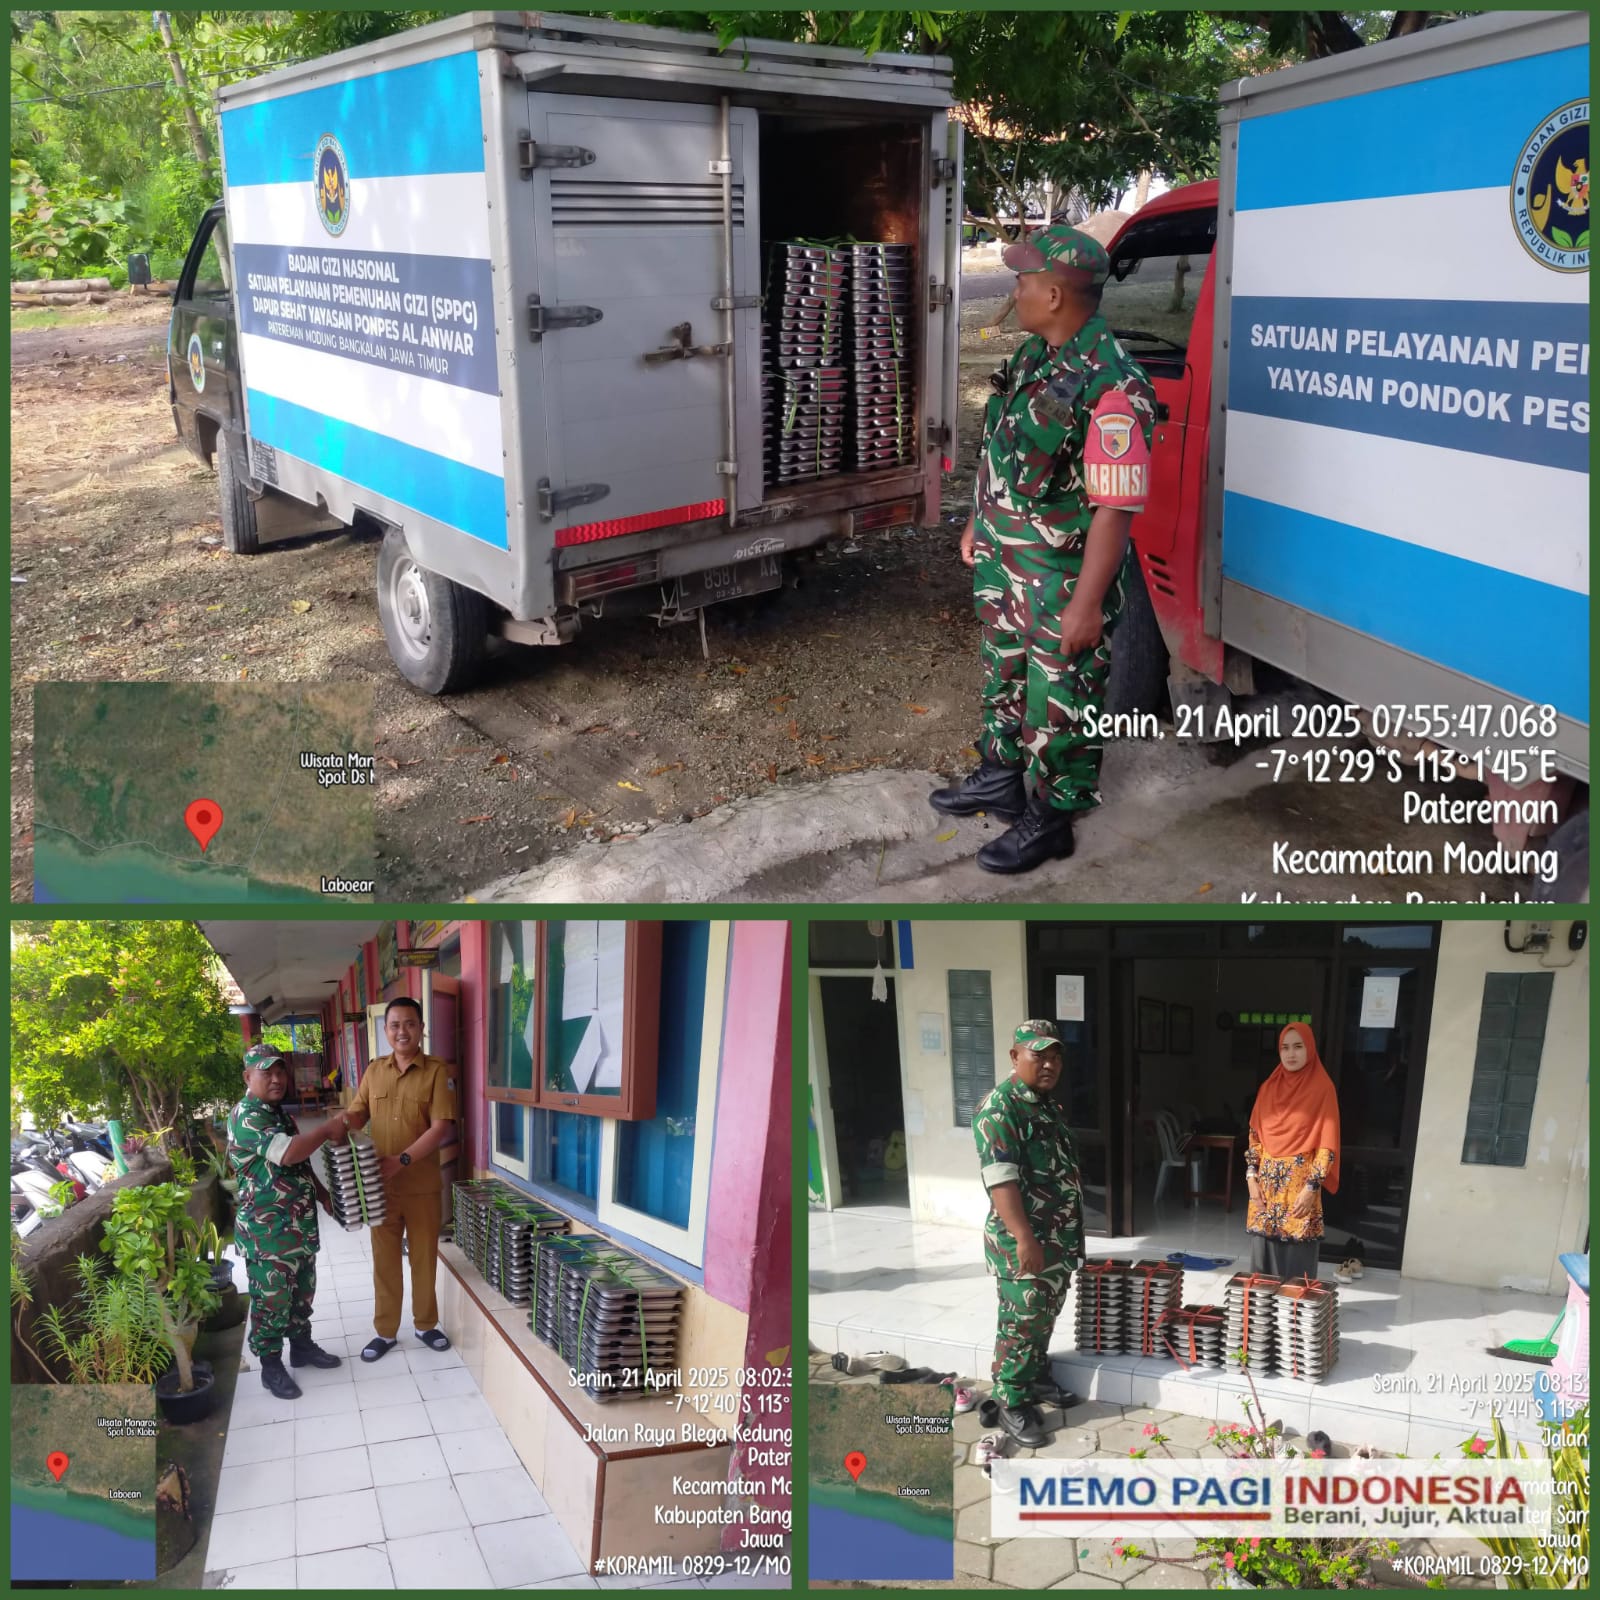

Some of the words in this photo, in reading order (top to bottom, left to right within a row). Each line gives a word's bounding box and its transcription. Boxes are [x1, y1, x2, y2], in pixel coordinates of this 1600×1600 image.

[1522, 123, 1556, 174] BADAN
[1559, 106, 1587, 126] GIZI
[1519, 209, 1566, 264] REPUBLIK
[1572, 252, 1590, 265] IN
[288, 254, 320, 275] BADAN
[322, 257, 341, 277] GIZI
[343, 259, 399, 283] NASIONAL
[248, 273, 278, 293] SATUAN
[278, 277, 331, 300] PELAYANAN
[332, 284, 401, 312] PEMENUHAN
[403, 293, 429, 317] GIZI
[431, 295, 478, 331] (SPPG)
[252, 296, 279, 317] DAPUR
[280, 301, 307, 322] SEHAT
[308, 305, 353, 331] YAYASAN
[354, 314, 400, 341] PONPES
[402, 324, 419, 345] AL
[421, 327, 474, 356] ANWAR
[267, 321, 304, 342] PATEREMAN
[305, 330, 337, 350] MODUNG
[339, 338, 387, 361] BANGKALAN
[390, 348, 415, 368] JAWA
[418, 353, 449, 375] TIMUR
[1251, 323, 1338, 353] SATUAN
[1345, 329, 1519, 369] PELAYANAN
[1531, 340, 1590, 376] PE
[1267, 366, 1373, 403] YAYASAN
[1382, 379, 1511, 423] PONDOK
